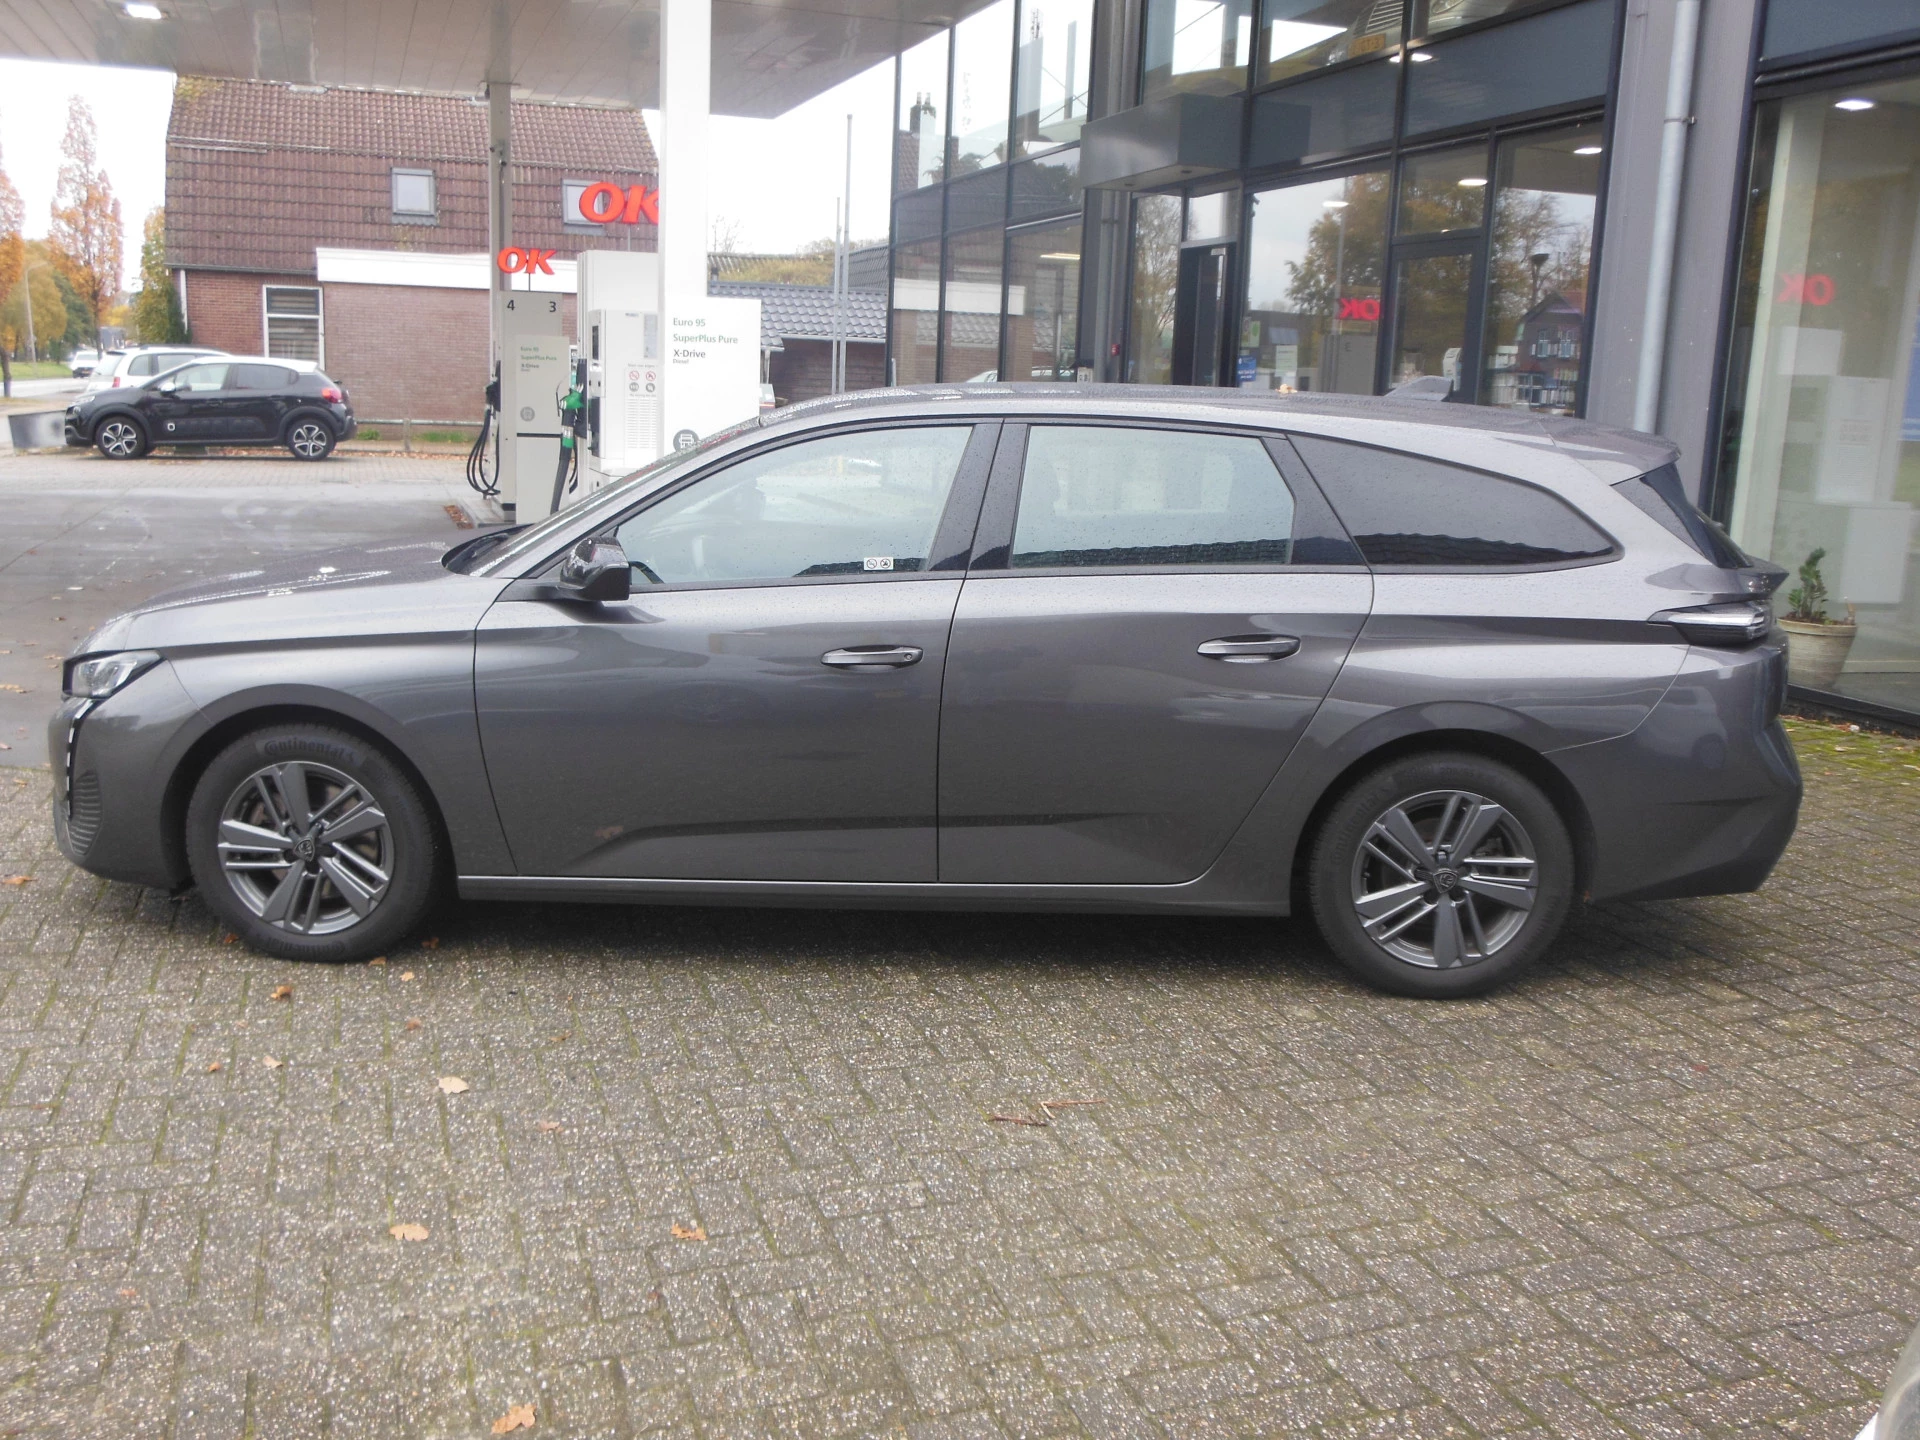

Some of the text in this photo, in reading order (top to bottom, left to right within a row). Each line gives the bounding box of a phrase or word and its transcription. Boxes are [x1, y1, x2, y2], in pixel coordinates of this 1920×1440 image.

[579, 181, 659, 224] OK
[497, 246, 557, 275] OK
[507, 299, 515, 311] 4
[549, 301, 557, 313] 3
[673, 317, 706, 327] Euro 95
[673, 333, 739, 344] SuperPlus Pure
[673, 349, 706, 358] X-Drive
